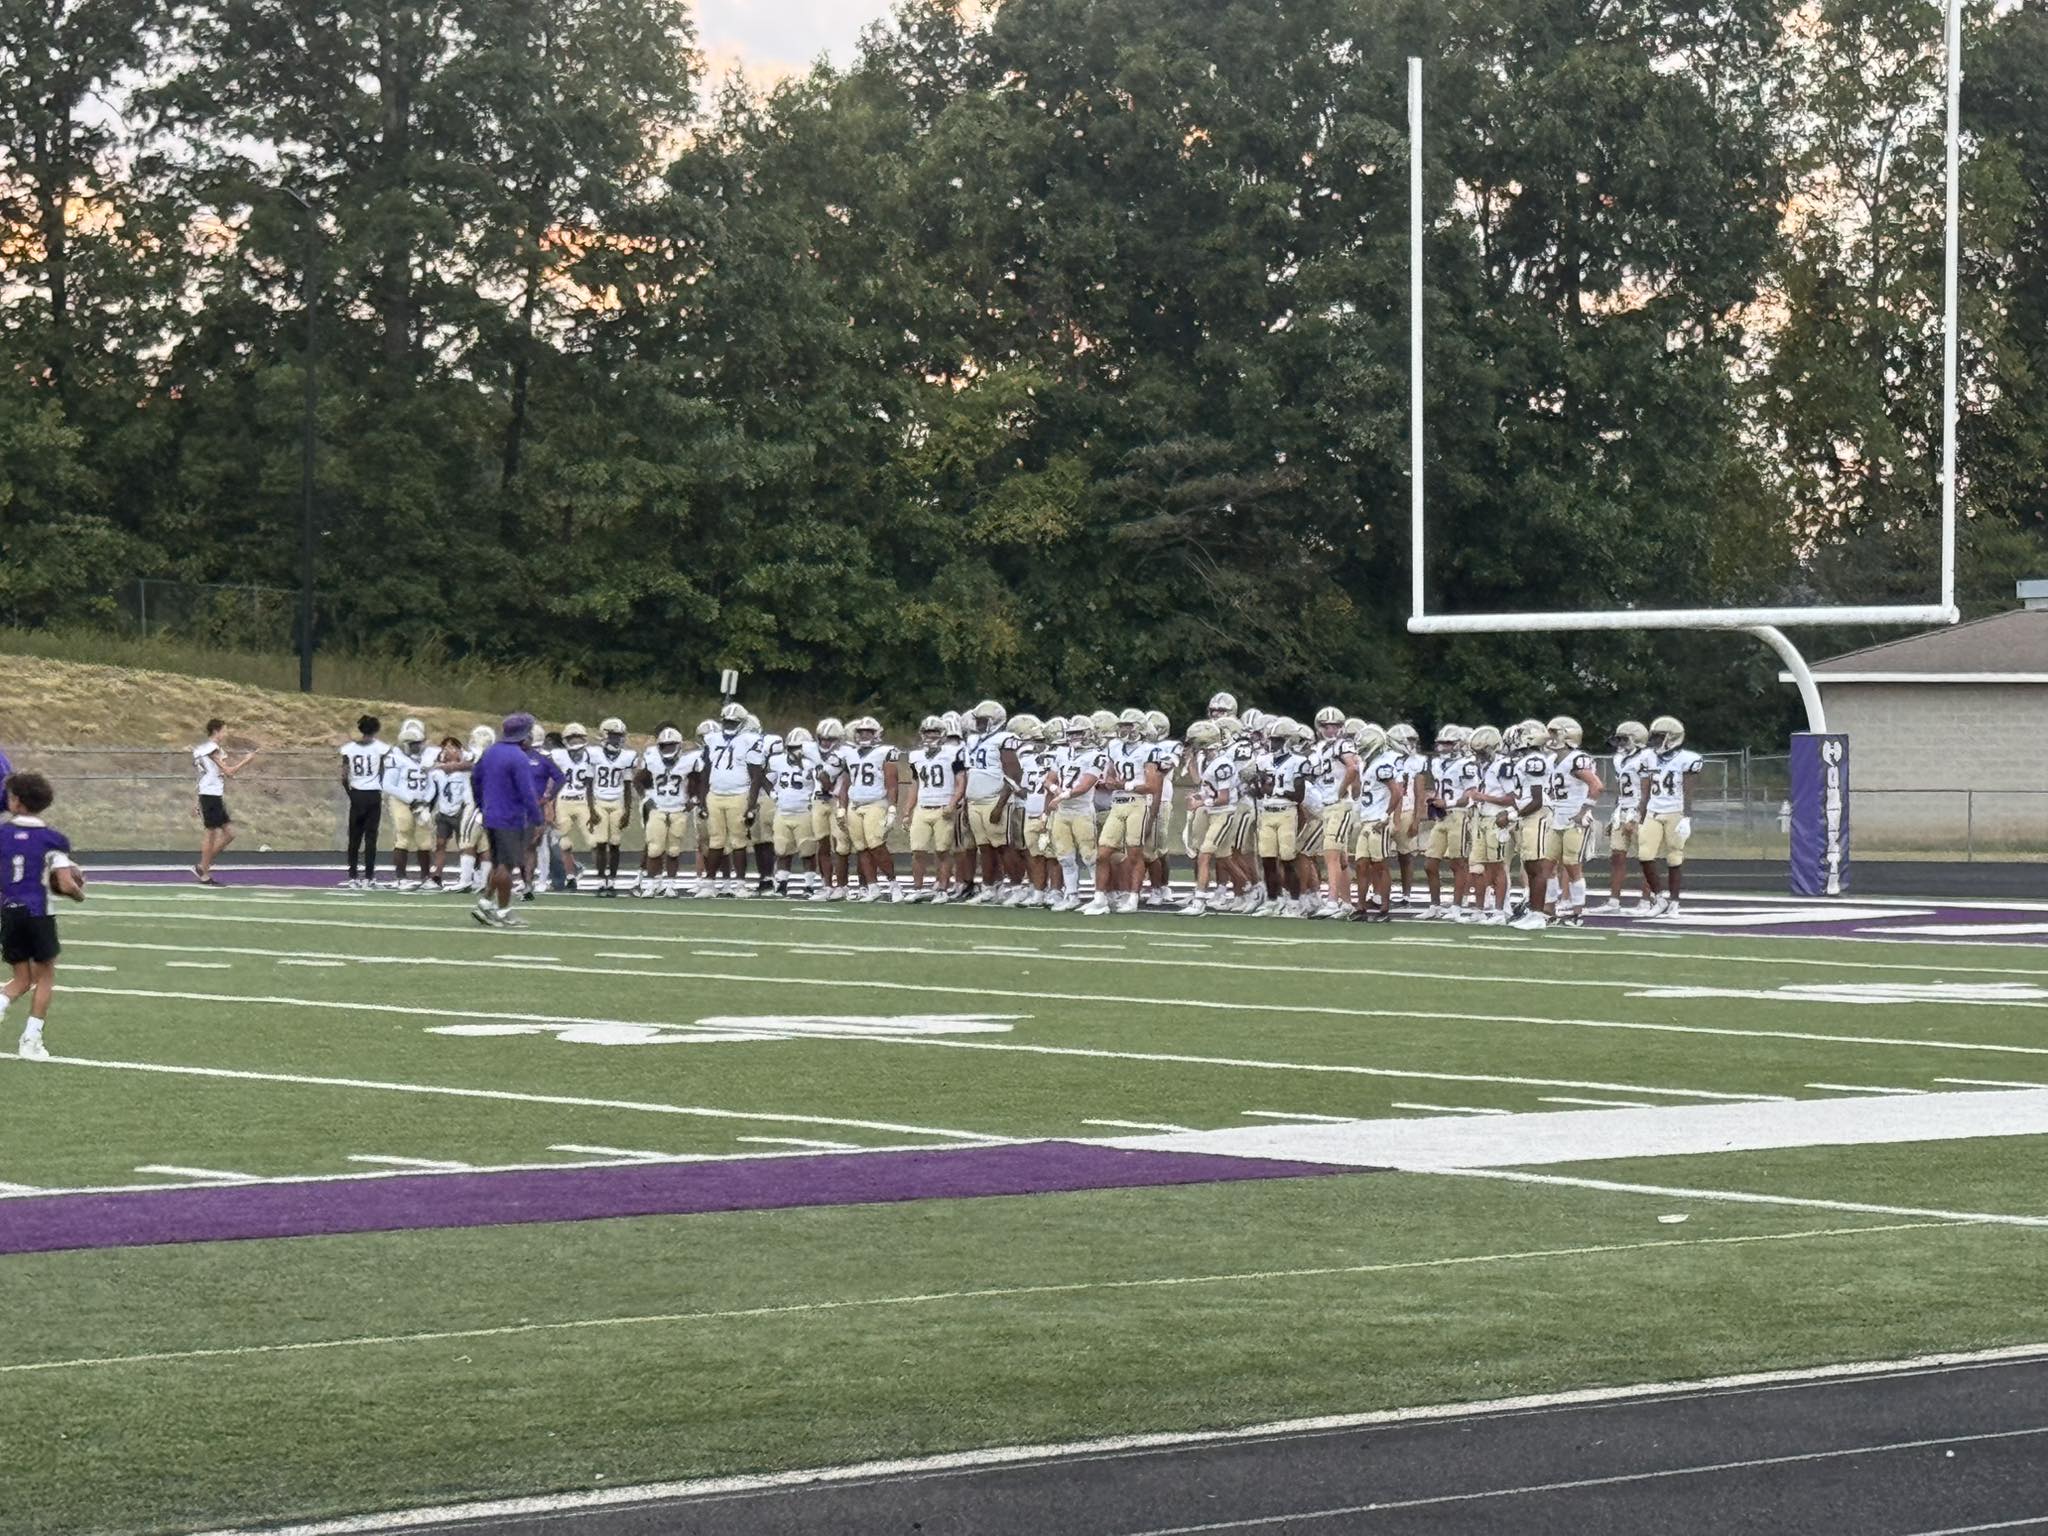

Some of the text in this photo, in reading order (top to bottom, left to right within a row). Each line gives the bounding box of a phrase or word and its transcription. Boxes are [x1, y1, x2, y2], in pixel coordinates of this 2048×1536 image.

[715, 745, 734, 770] 71
[598, 766, 622, 787] 80
[656, 774, 682, 796] 23
[850, 763, 874, 786] 76
[919, 764, 943, 787] 40
[13, 854, 25, 883] 1
